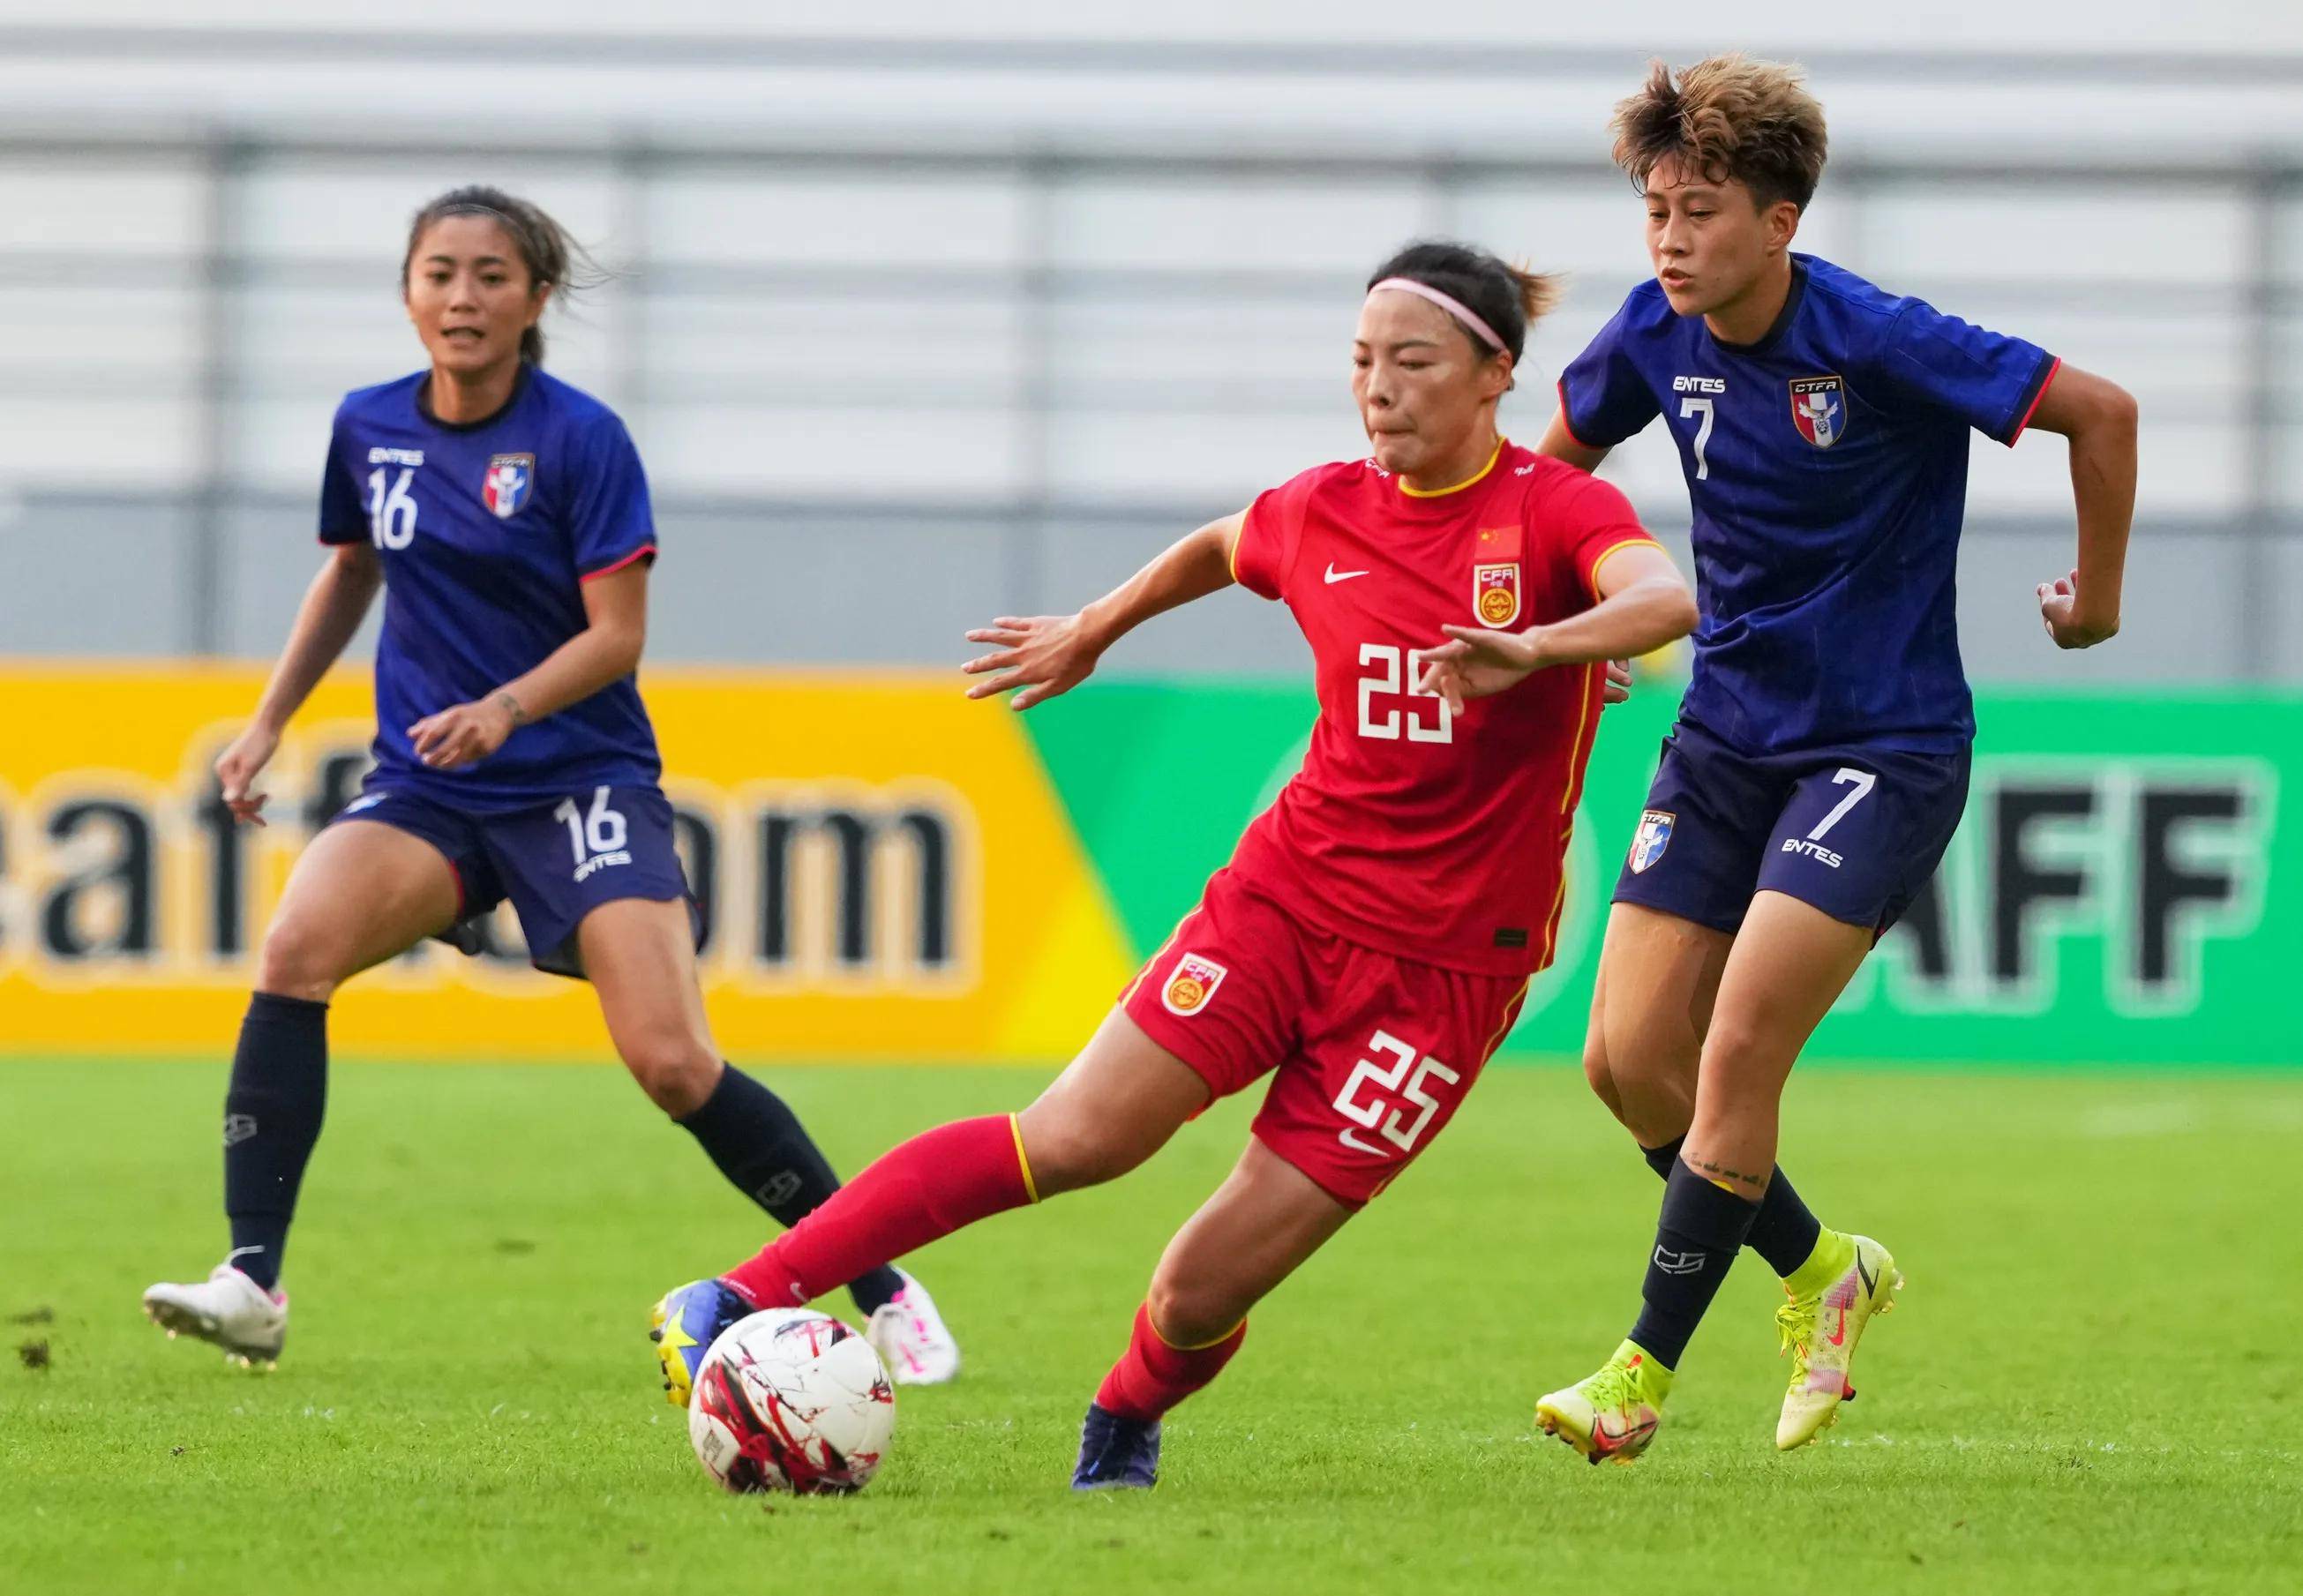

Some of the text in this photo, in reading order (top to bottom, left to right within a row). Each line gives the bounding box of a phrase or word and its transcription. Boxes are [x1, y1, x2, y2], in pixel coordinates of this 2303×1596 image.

[1673, 376, 1725, 393] ENTES
[1795, 381, 1837, 393] CTFA
[1680, 397, 1714, 480] 7
[369, 467, 418, 551] 16
[1359, 642, 1453, 744] 25
[553, 784, 627, 864] 16
[1806, 767, 1877, 841] 7
[1782, 838, 1843, 868] ENTES
[1333, 1030, 1460, 1151] 25
